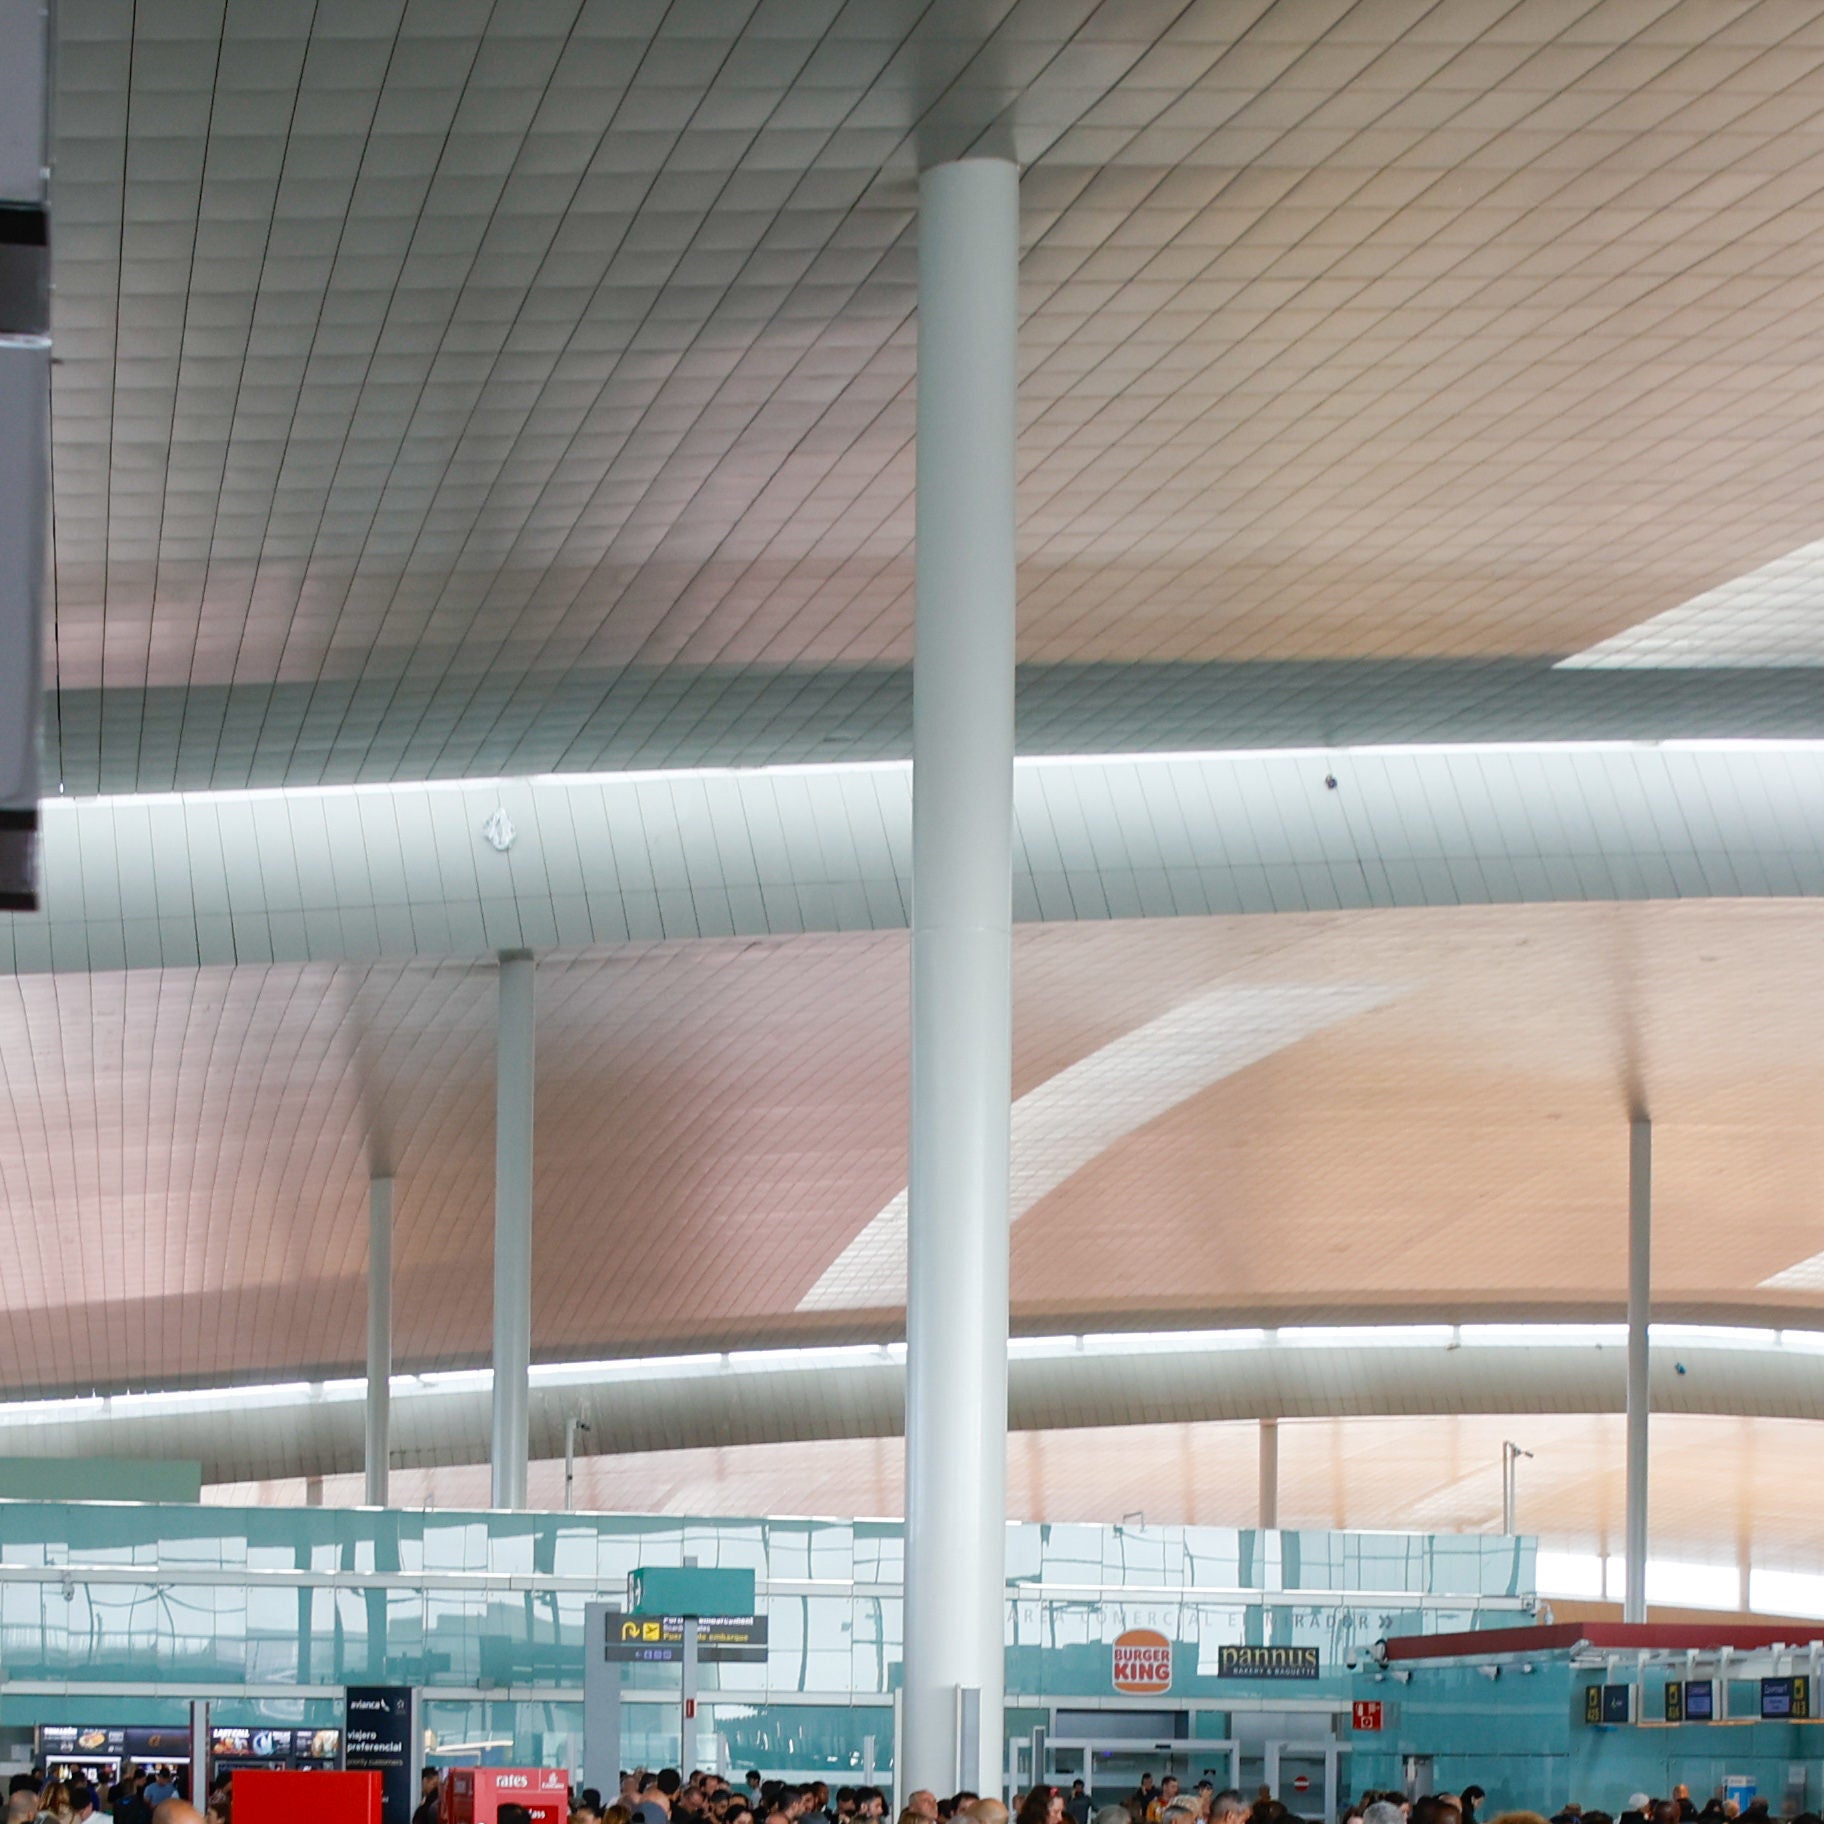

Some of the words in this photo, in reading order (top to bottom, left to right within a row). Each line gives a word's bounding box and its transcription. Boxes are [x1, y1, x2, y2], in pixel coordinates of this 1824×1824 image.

[1114, 1649, 1170, 1662] BURGER
[1222, 1647, 1317, 1672] pannus
[1114, 1663, 1170, 1681] KING
[351, 1699, 381, 1710] avianca
[347, 1729, 377, 1742] viajero
[347, 1741, 403, 1753] preferencial
[496, 1773, 528, 1788] rates
